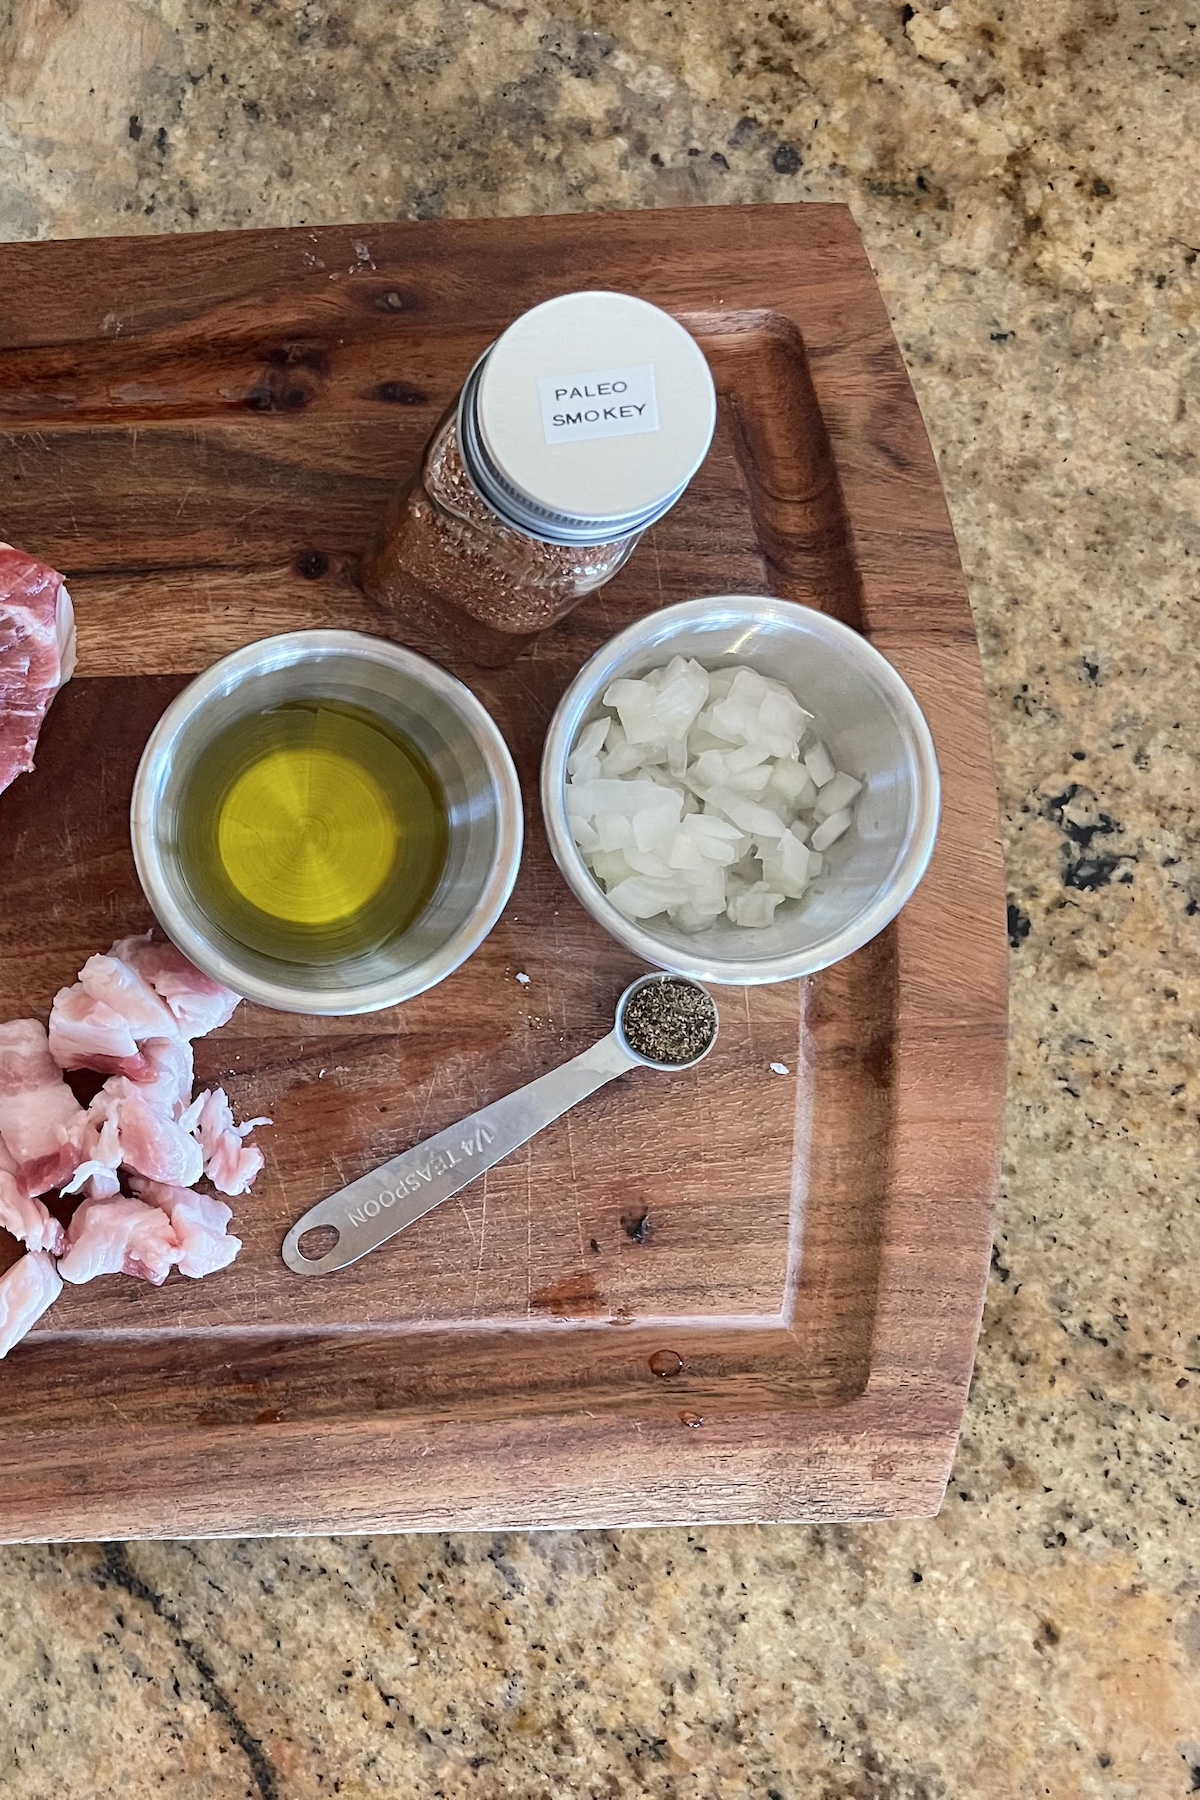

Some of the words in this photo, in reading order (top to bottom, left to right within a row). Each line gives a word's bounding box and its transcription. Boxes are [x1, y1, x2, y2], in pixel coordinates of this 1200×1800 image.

[555, 381, 628, 401] PALEO
[552, 403, 647, 427] SMOKEY
[461, 1128, 495, 1156] 1/4
[347, 1149, 462, 1228] TEASPOON
